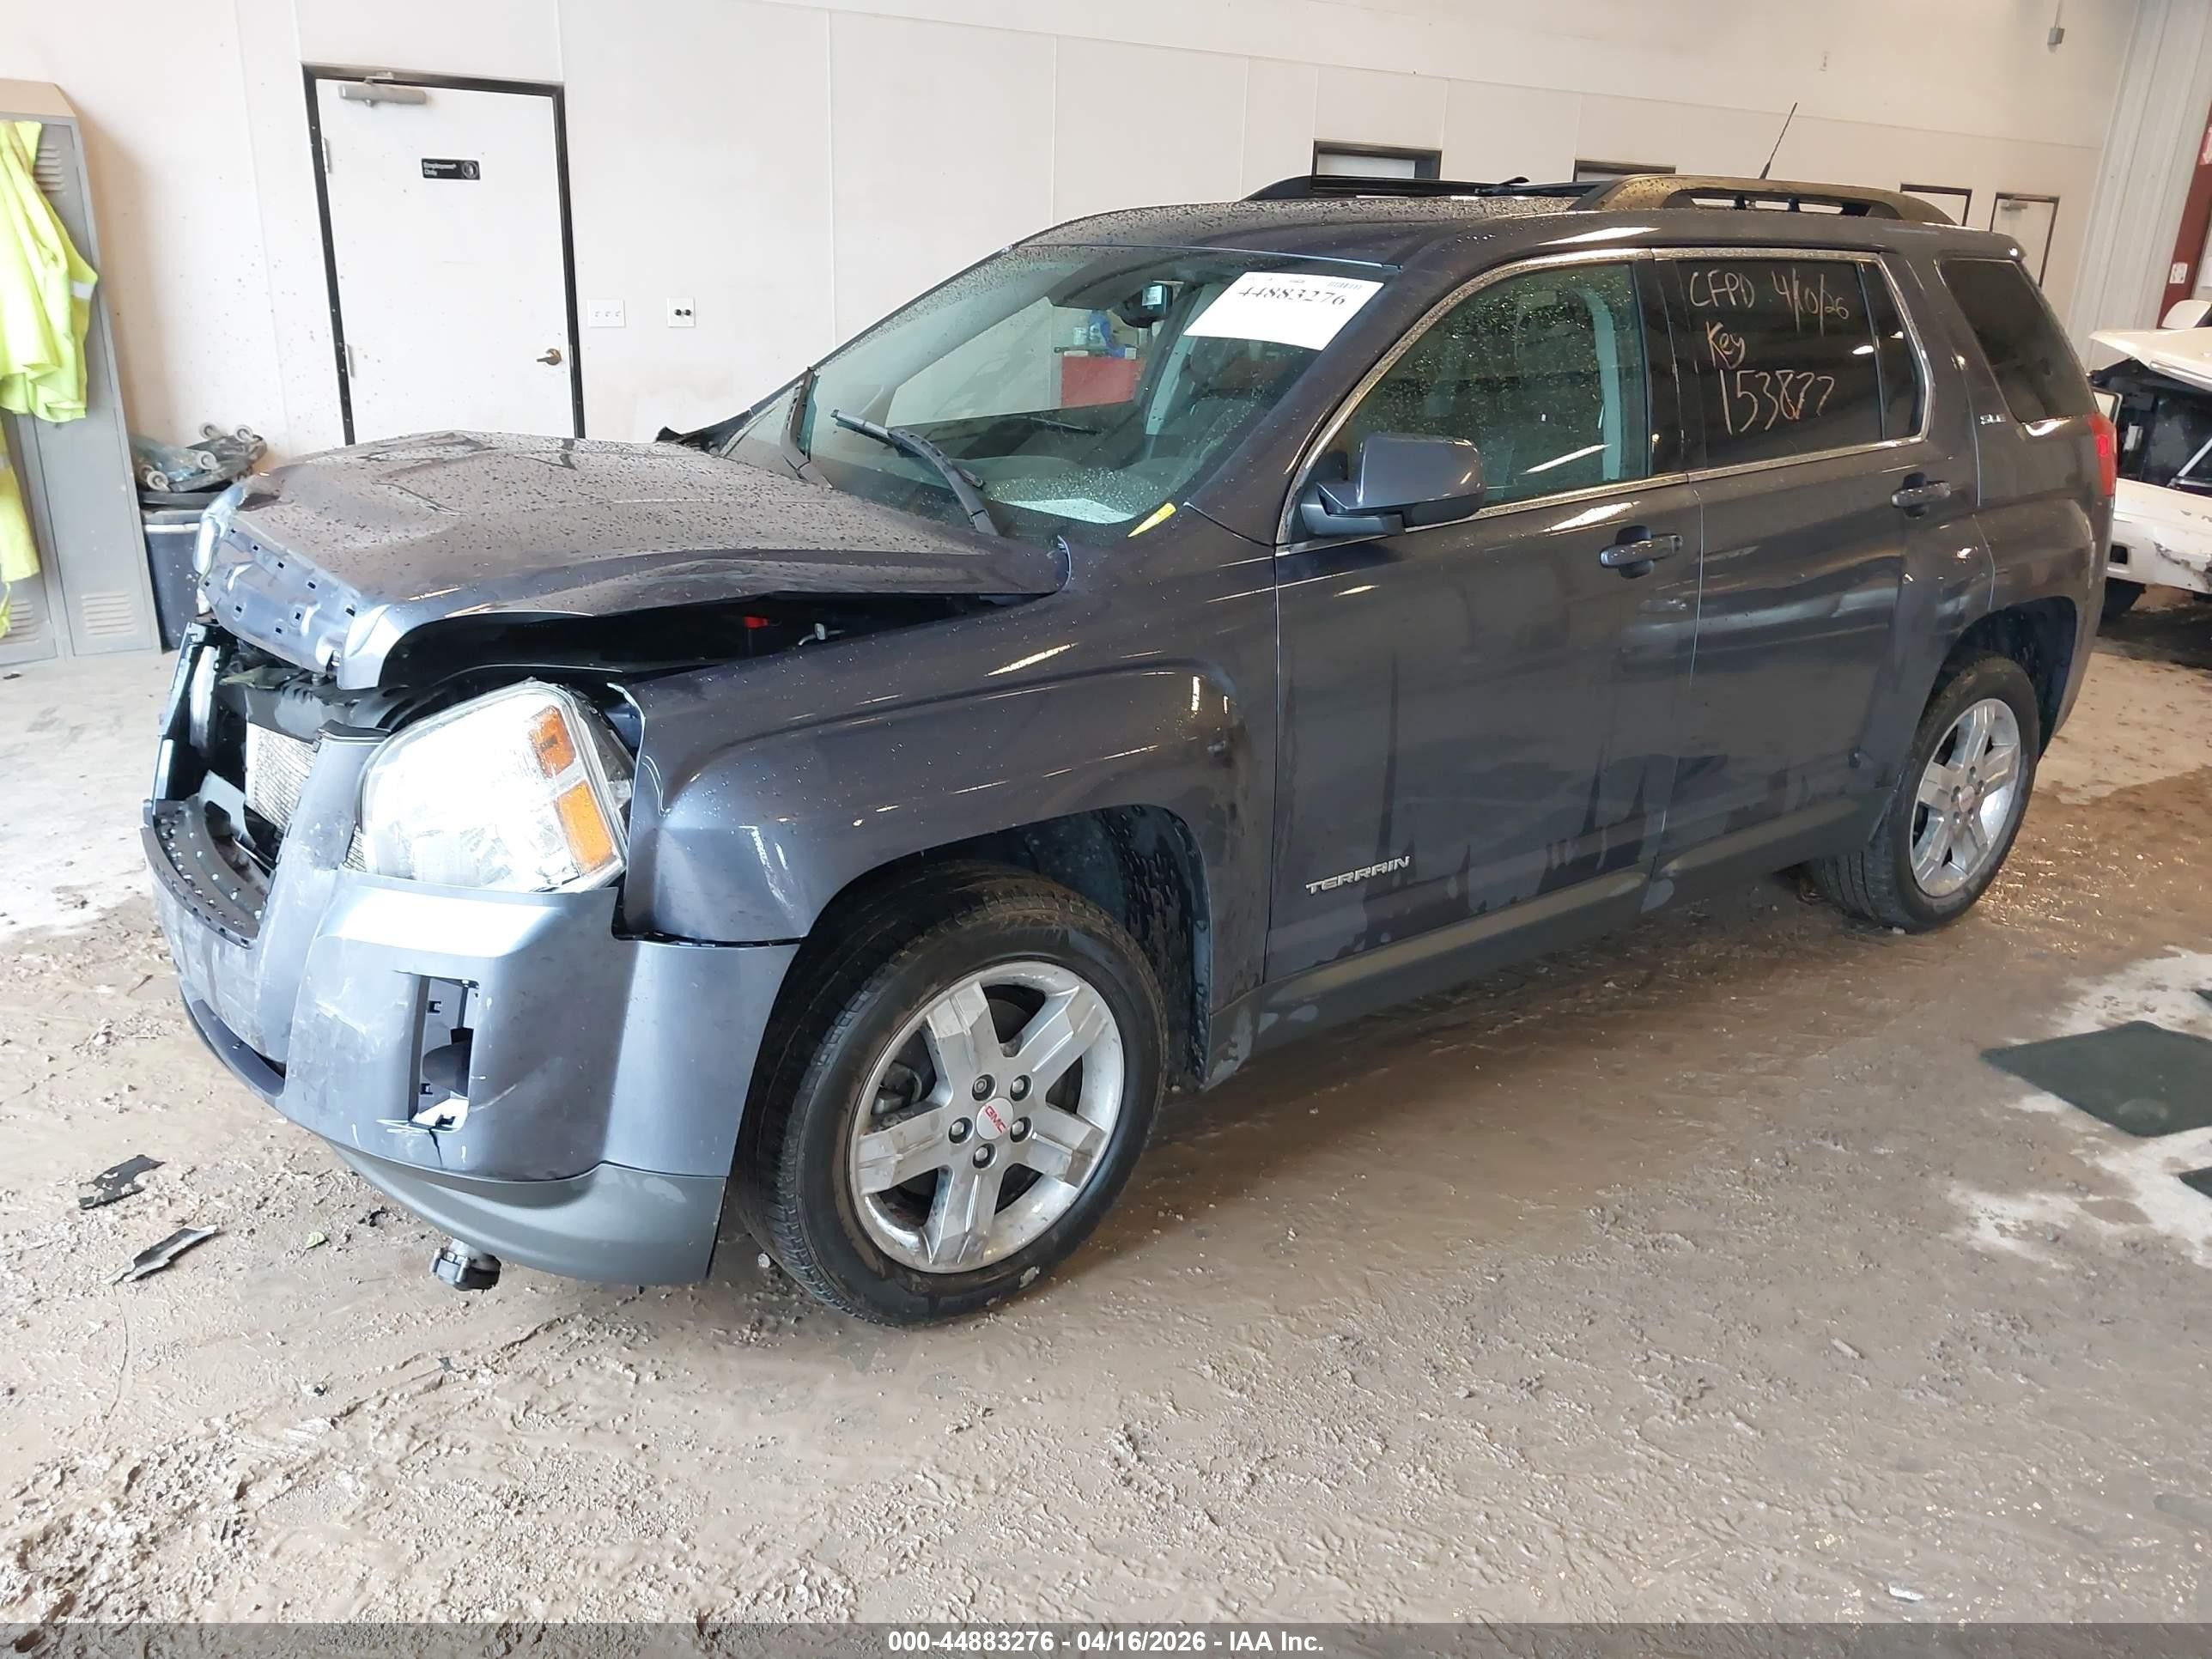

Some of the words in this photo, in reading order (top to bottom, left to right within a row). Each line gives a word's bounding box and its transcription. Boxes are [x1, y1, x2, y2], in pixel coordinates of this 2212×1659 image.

[1237, 286, 1347, 306] 44883276
[1688, 269, 1756, 309] CFPD
[1705, 320, 1747, 370] Key
[1305, 855, 1411, 895] TERRAIN
[984, 1105, 1007, 1134] GMC
